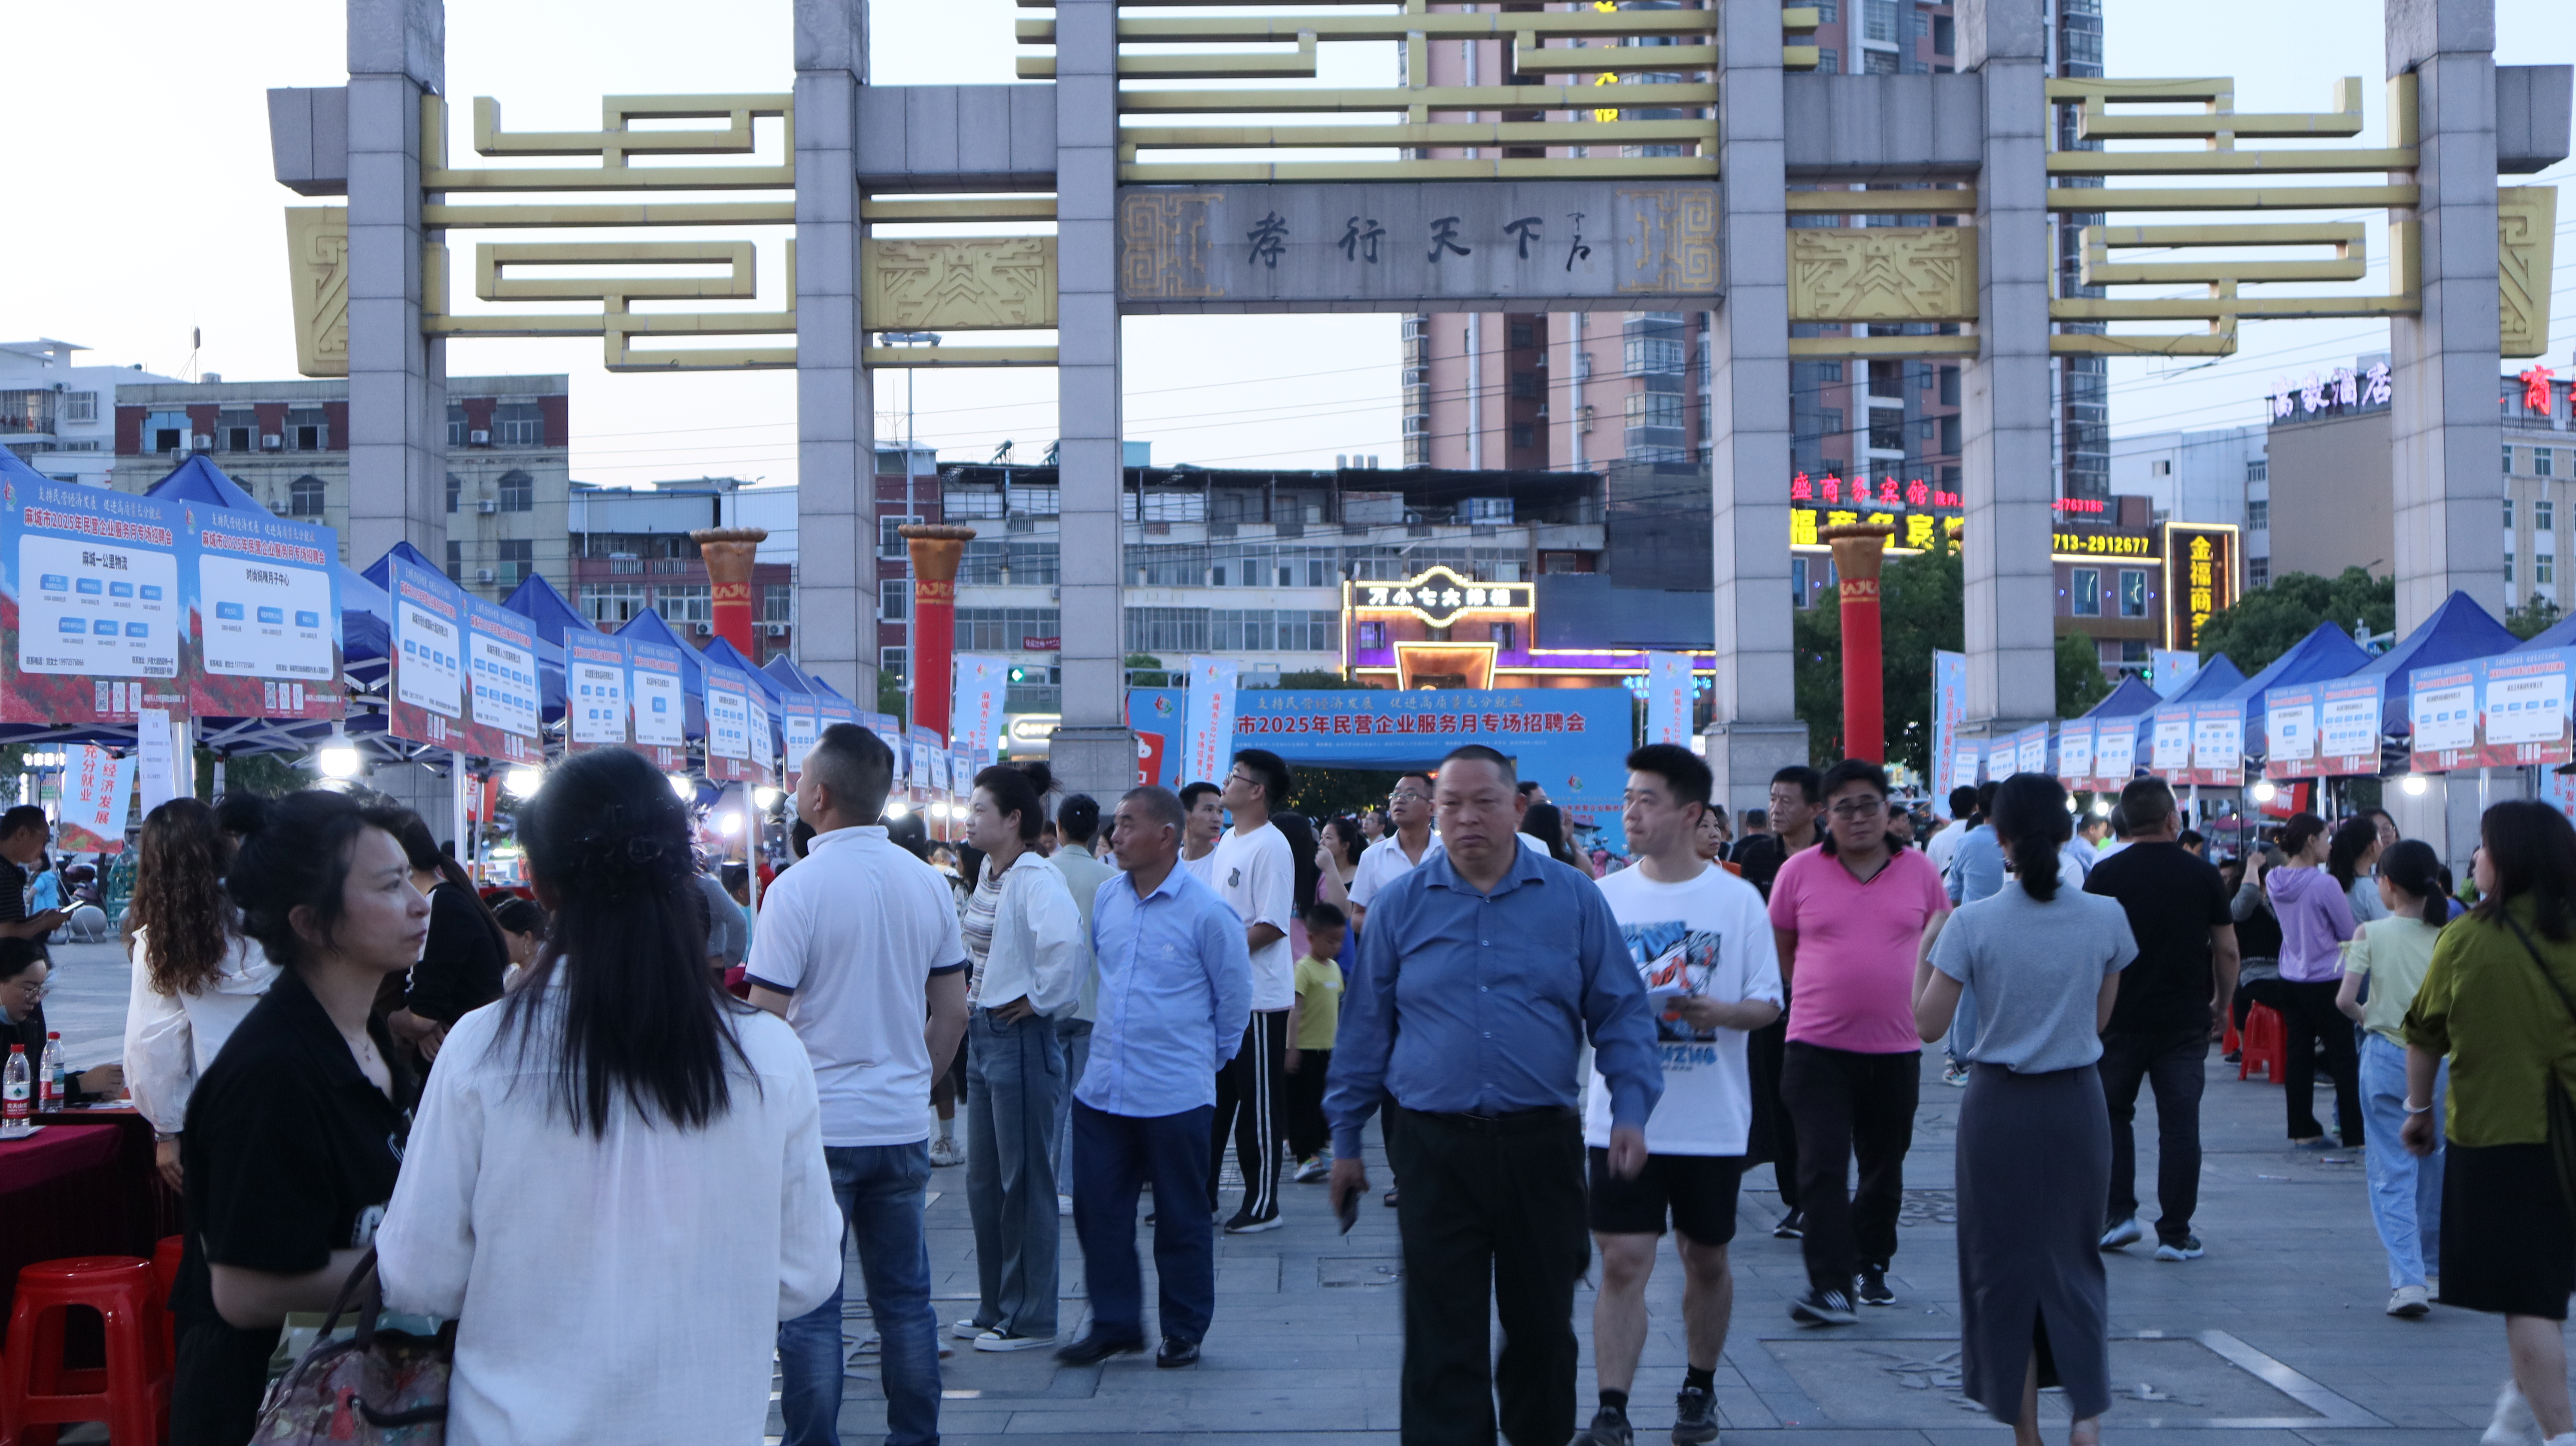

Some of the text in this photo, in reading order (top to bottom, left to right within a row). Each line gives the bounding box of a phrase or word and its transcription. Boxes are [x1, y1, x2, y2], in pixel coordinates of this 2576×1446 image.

[1247, 211, 1542, 268] 孝行天下
[39, 485, 97, 510] 支持民营经济发展
[1791, 471, 1929, 506] 盛商务宾馆
[24, 506, 173, 545] 麻城市2025年民营企业服务月专场招聘会
[201, 530, 325, 565] 麻城市2025年民营企业服务月专场招聘会
[2053, 533, 2149, 554] 713-2912677
[82, 550, 128, 571] 麻城一公里物流
[1258, 694, 1524, 711] 支持民营经济发展 促进高质量充分就业
[1232, 712, 1587, 735] 市2025年民营企业服务月专场招聘会
[79, 746, 98, 802] 充分就业
